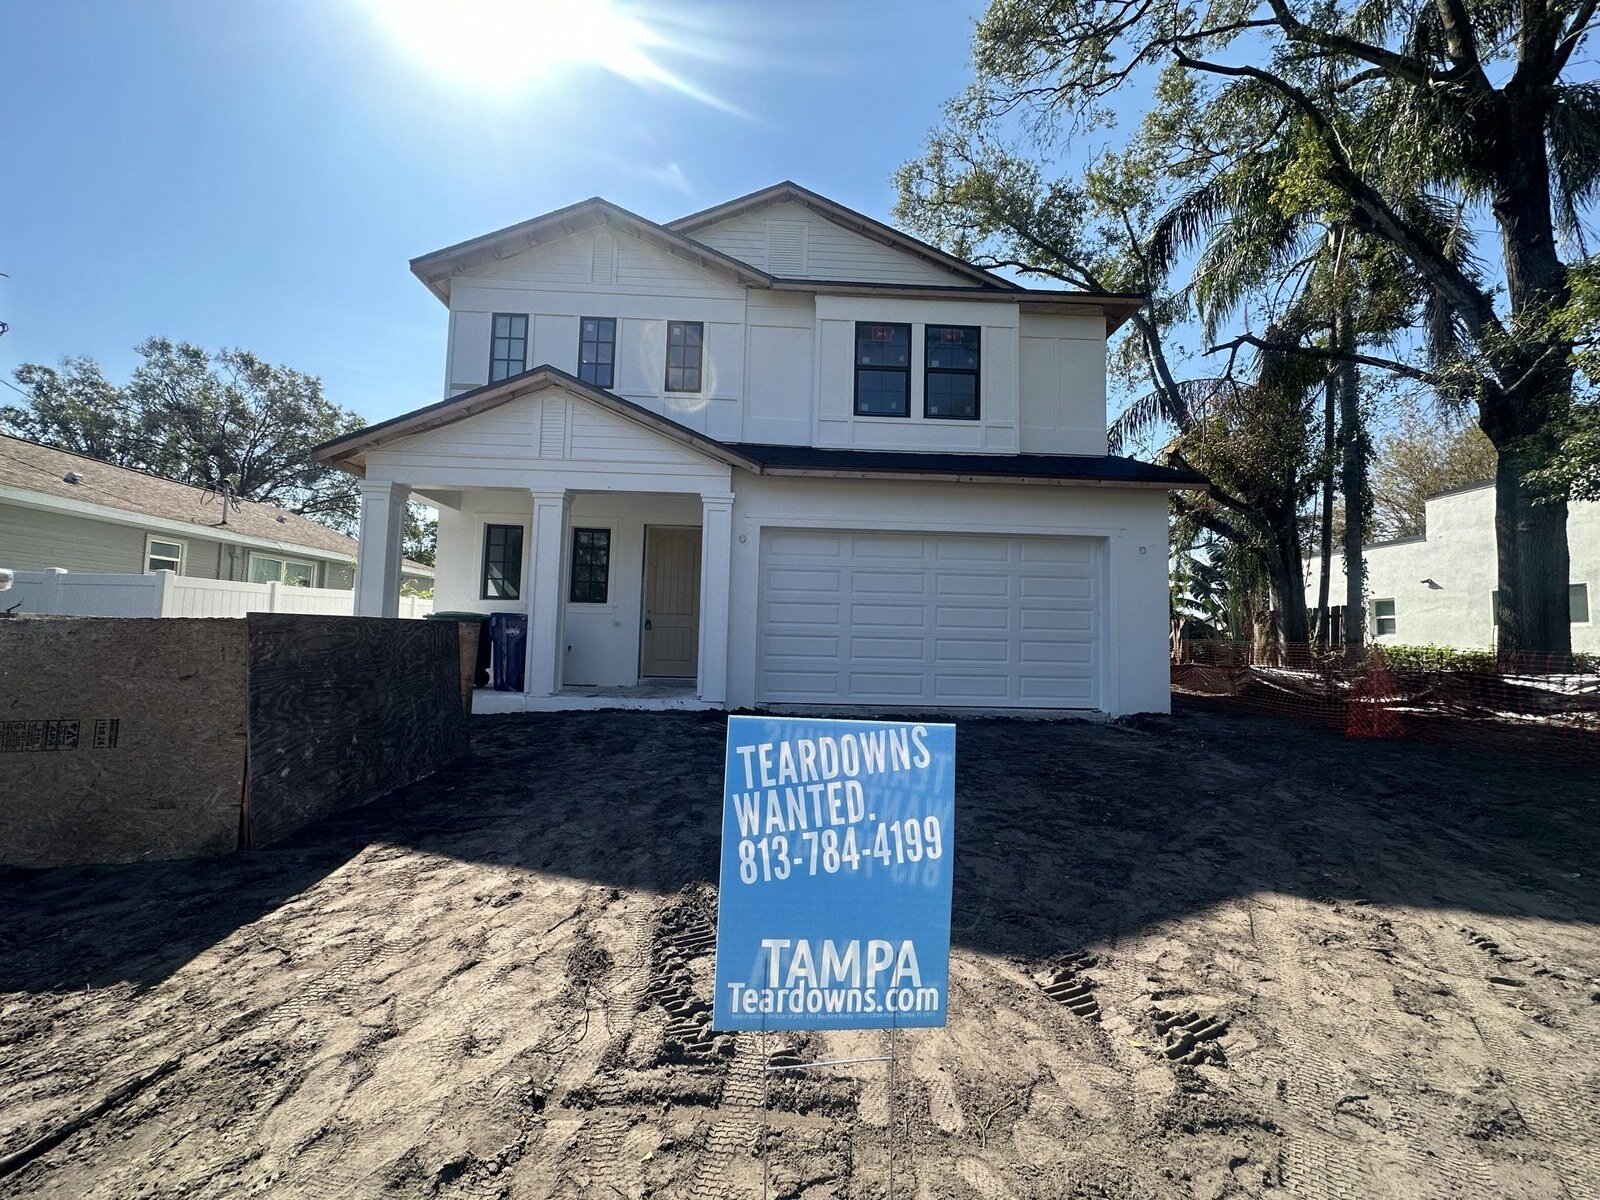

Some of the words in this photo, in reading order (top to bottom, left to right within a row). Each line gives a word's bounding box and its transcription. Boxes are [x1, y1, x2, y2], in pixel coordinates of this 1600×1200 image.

[736, 725, 931, 789] TEARDOWNS
[732, 780, 876, 837] WANTED.
[738, 815, 942, 885] 813-784-4199
[761, 939, 922, 988] TAMPA
[727, 979, 939, 1013] Teardowns.com
